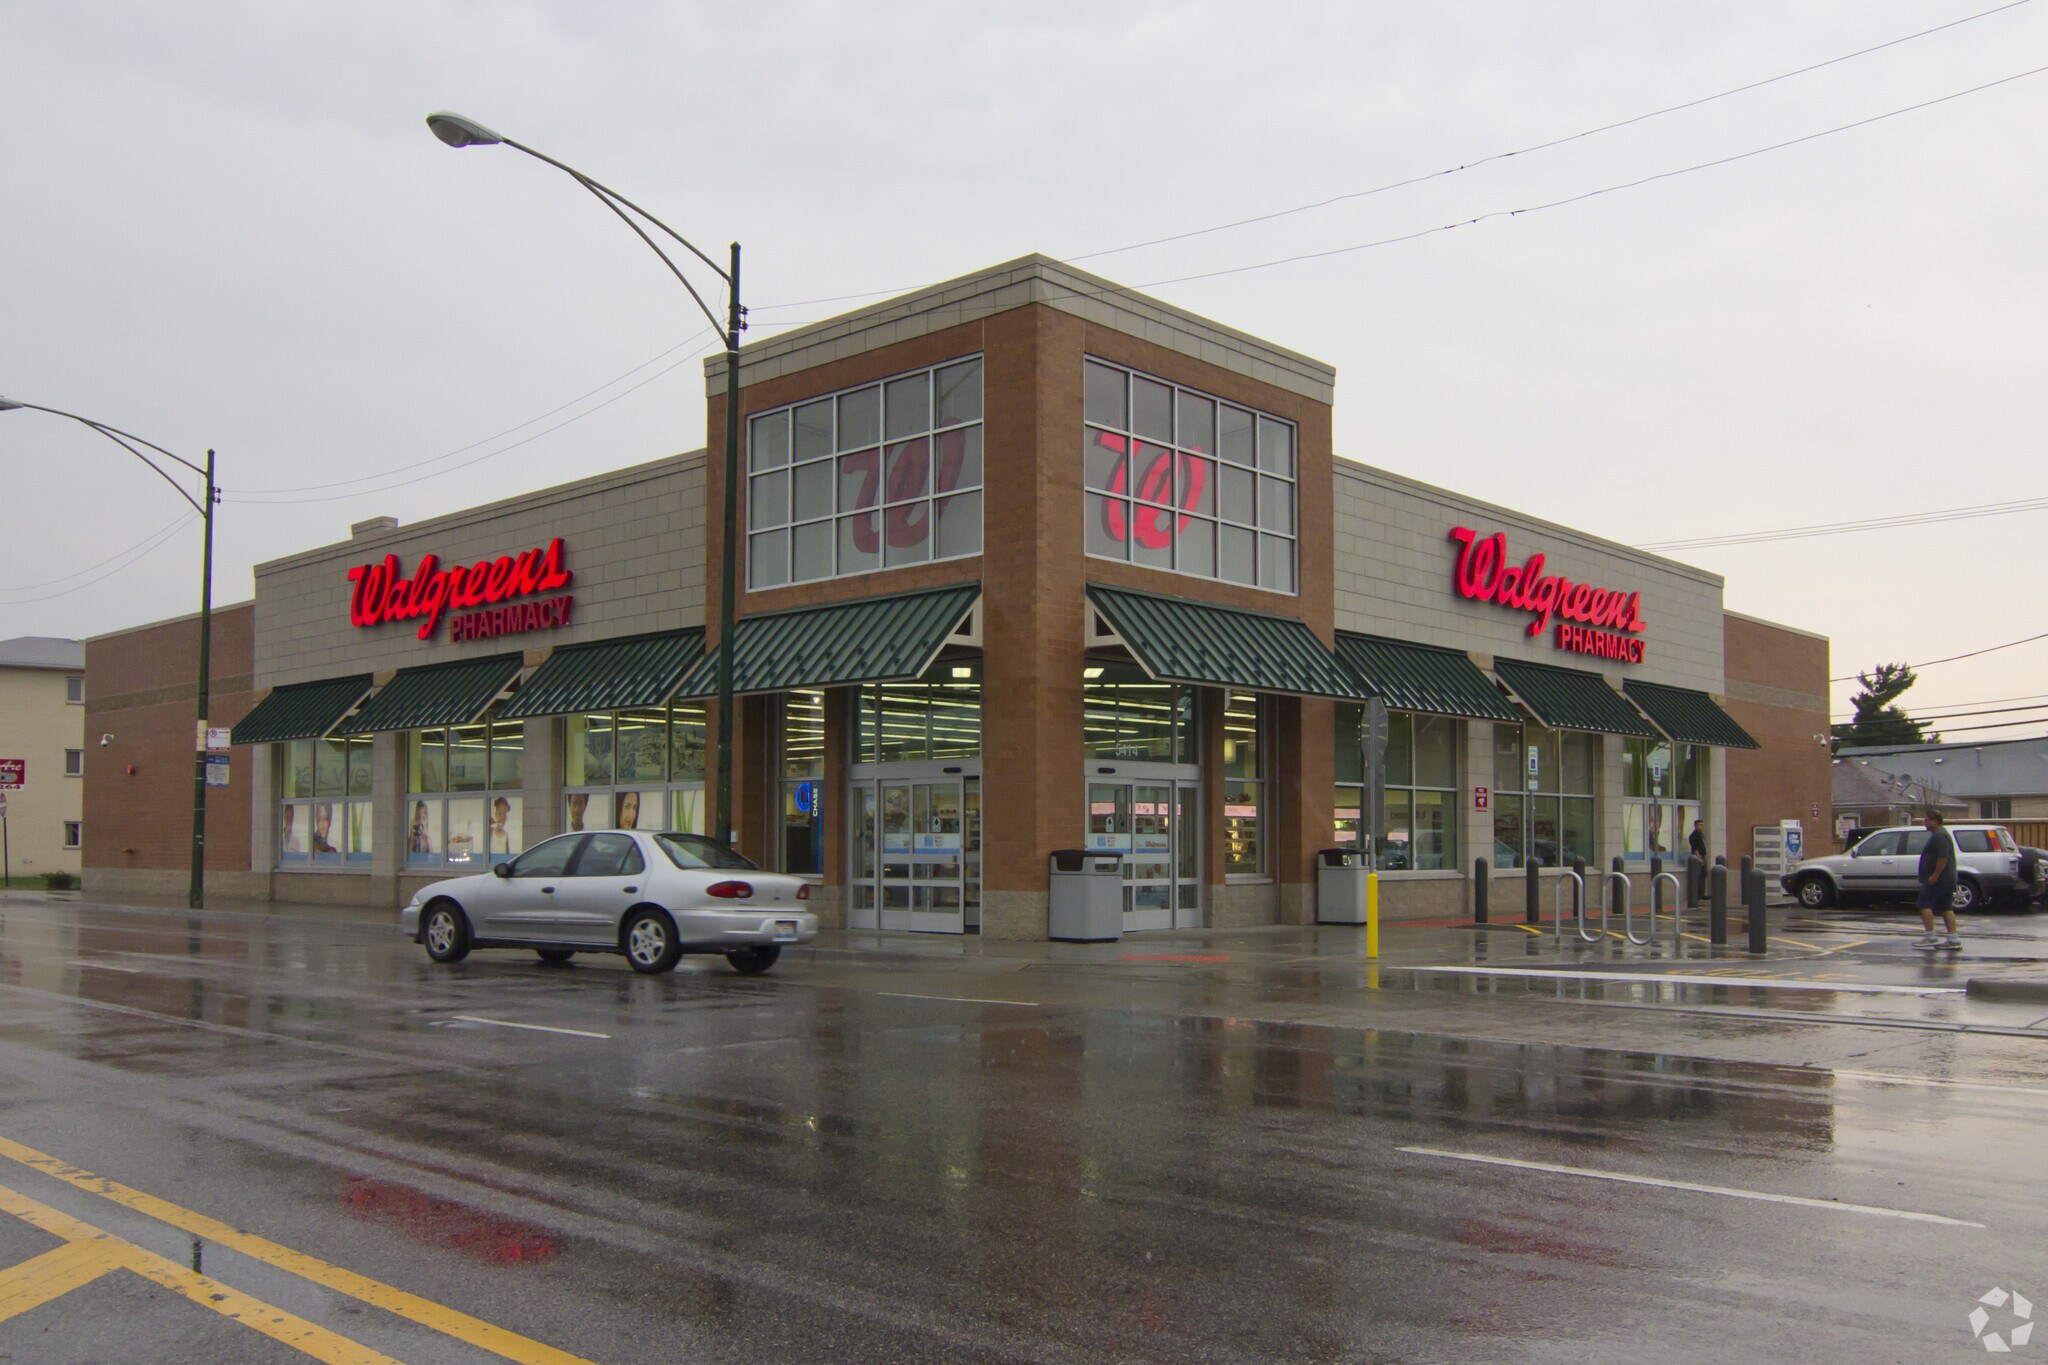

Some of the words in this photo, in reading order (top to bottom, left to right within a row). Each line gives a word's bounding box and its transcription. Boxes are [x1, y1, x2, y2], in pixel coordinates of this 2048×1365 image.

[1093, 429, 1206, 549] W
[347, 537, 573, 640] Walgreens
[450, 595, 574, 643] PHARMACY
[1449, 526, 1648, 638] Walgreens
[1557, 623, 1648, 664] PHARMACY
[1115, 743, 1139, 757] 5414
